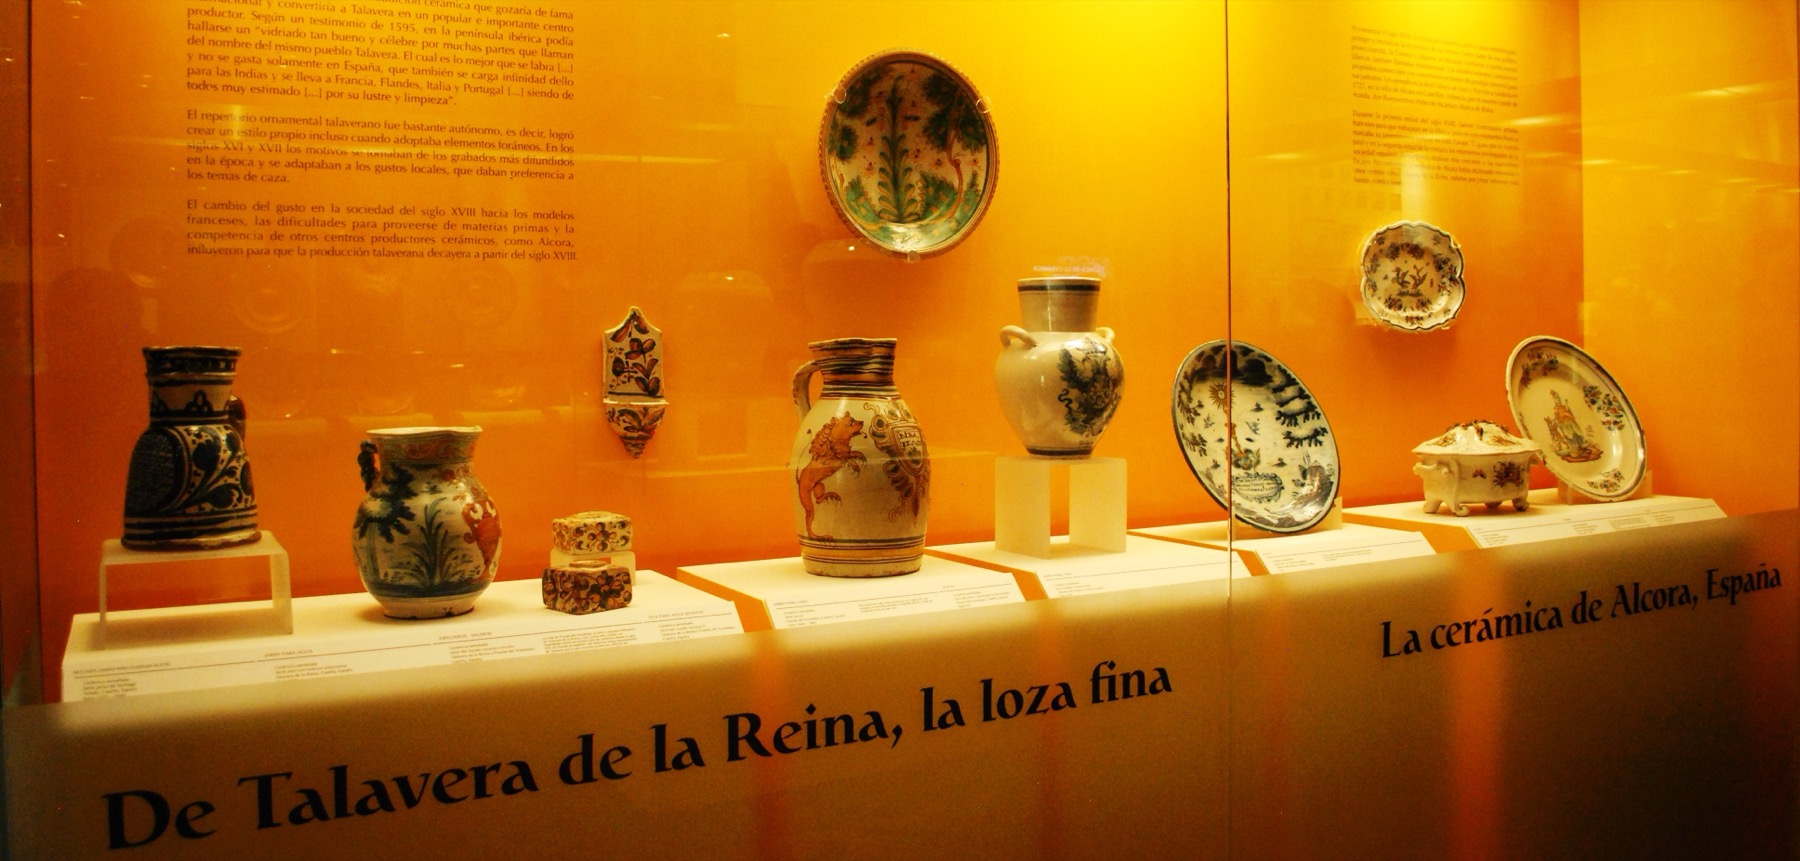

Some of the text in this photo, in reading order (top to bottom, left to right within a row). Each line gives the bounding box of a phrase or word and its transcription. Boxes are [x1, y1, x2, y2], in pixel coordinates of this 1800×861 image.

[187, 21, 232, 33] hallarse
[311, 29, 327, 40] tan
[331, 30, 365, 42] bueno
[370, 36, 375, 46] y
[380, 34, 418, 46] célebre
[422, 39, 439, 50] por
[443, 38, 482, 51] muchas
[486, 42, 515, 56] partes
[519, 47, 537, 58] que
[541, 46, 574, 59] llaman
[251, 10, 285, 25] Según
[309, 14, 366, 28] testimonio
[371, 19, 384, 30] de
[424, 26, 436, 34] en
[442, 24, 450, 35] la
[455, 25, 503, 41] península
[509, 29, 542, 42] ibérica
[546, 32, 573, 47] podía
[187, 52, 193, 62] y
[198, 53, 214, 61] no
[218, 54, 230, 62] se
[234, 53, 262, 67] gasta
[267, 55, 323, 68] solamente
[326, 61, 340, 69] en
[388, 65, 408, 76] que
[412, 64, 454, 77] también
[472, 71, 498, 82] carga
[503, 70, 546, 83] infinidad
[550, 74, 574, 85] dello
[187, 80, 218, 91] todos
[222, 84, 246, 95] muy
[250, 83, 300, 96] estimado
[326, 90, 344, 101] por
[363, 89, 391, 101] lustre
[395, 94, 400, 103] y
[187, 109, 197, 120] El
[260, 113, 322, 126] ornamental
[326, 116, 381, 129] talaverano
[384, 119, 400, 130] fue
[404, 120, 446, 132] bastante
[549, 128, 574, 141] logró
[186, 127, 215, 136] crear
[269, 128, 306, 142] propio
[309, 130, 349, 141] incluso
[351, 132, 391, 143] cuando
[394, 134, 441, 148] adoptaba
[444, 136, 496, 148] elementos
[546, 141, 558, 152] En
[560, 142, 574, 152] los
[187, 169, 203, 179] los
[207, 169, 240, 180] temas
[244, 170, 258, 181] de
[206, 155, 216, 165] la
[220, 155, 254, 169] época
[258, 159, 265, 169] y
[285, 158, 342, 172] adaptaban
[356, 160, 371, 171] los
[374, 161, 407, 175] gustos
[453, 167, 473, 178] que
[476, 165, 507, 177] daban
[511, 167, 565, 182] preferencia
[187, 199, 197, 209] El
[204, 199, 247, 210] cambio
[253, 200, 270, 211] del
[276, 201, 306, 214] gusto
[331, 202, 341, 212] la
[346, 203, 395, 214] sociedad
[399, 204, 416, 214] del
[421, 205, 445, 218] siglo
[452, 206, 476, 216] XVIII
[481, 206, 508, 217] hacia
[514, 208, 528, 218] los
[533, 208, 574, 219] modelos
[187, 229, 264, 242] competencia
[269, 230, 285, 240] de
[290, 230, 319, 241] otros
[323, 231, 365, 242] centros
[371, 232, 436, 246] productores
[255, 215, 272, 226] las
[277, 216, 346, 228] dificultades
[352, 220, 377, 231] para
[383, 221, 437, 232] proveerse
[443, 220, 457, 230] de
[462, 220, 507, 231] materias
[514, 221, 549, 234] primas
[554, 225, 560, 234] y
[566, 222, 574, 232] la
[247, 248, 270, 258] para
[274, 248, 294, 258] que
[297, 246, 307, 256] la
[310, 246, 370, 259] producción
[373, 247, 424, 257] talaverana
[427, 247, 471, 260] decayera
[483, 248, 508, 261] partir
[511, 248, 526, 258] del
[529, 249, 550, 261] siglo
[1380, 563, 1782, 658] La cerámica de Alcora, España
[101, 660, 1172, 849] De Talavera de la Reina, la loza fina
